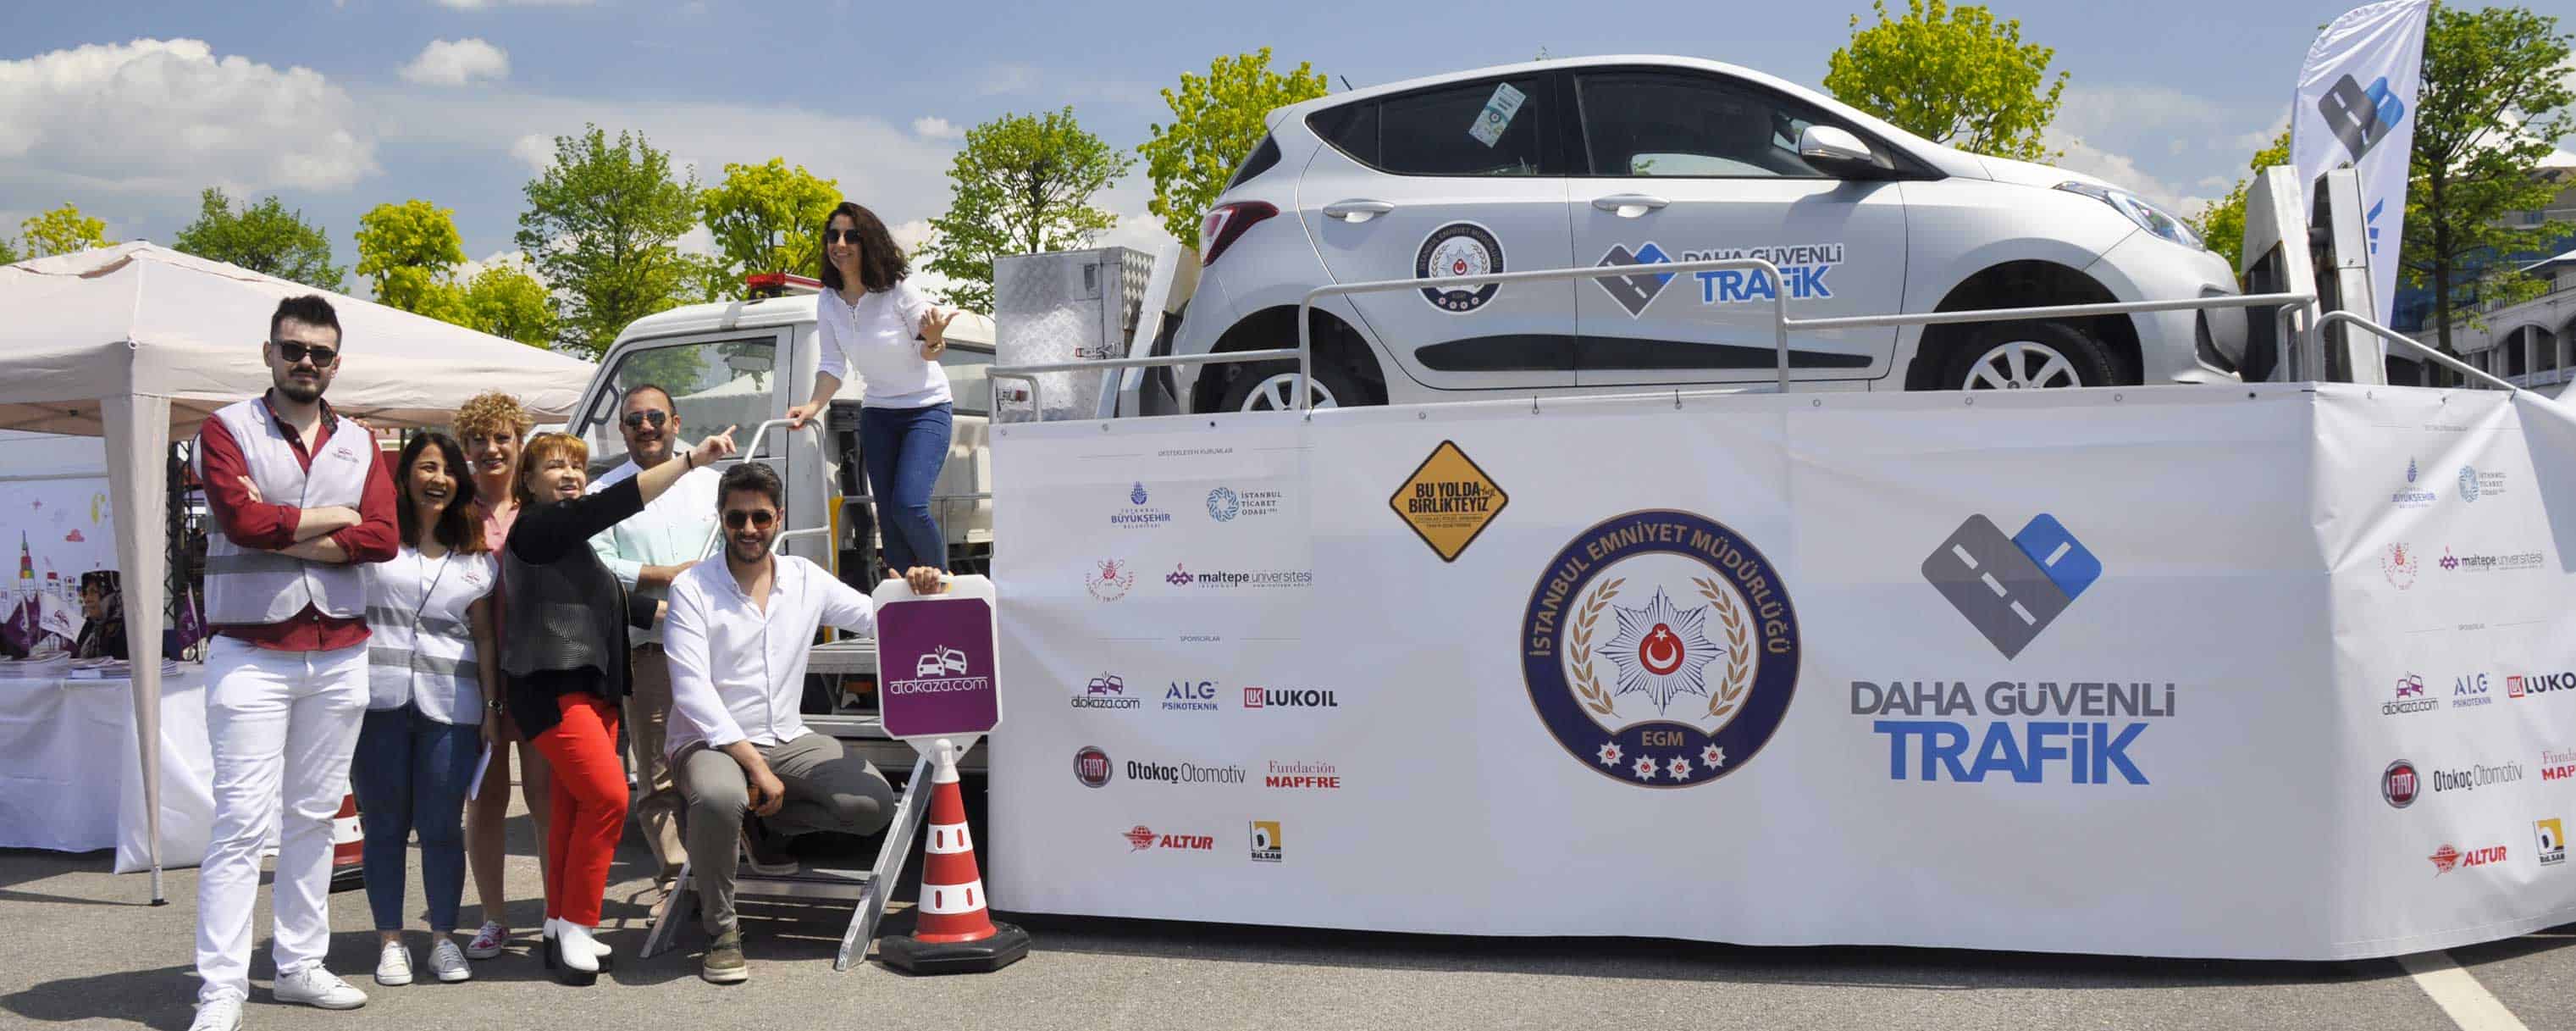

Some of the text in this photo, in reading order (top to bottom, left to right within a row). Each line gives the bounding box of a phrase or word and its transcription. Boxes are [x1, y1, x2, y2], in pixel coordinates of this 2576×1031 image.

[1416, 483, 1434, 497] BU
[1438, 481, 1480, 497] YOLDA
[2461, 553, 2496, 570] maltepe
[1198, 570, 1249, 587] maltepe
[1586, 521, 1688, 561] EMNİYET
[1690, 529, 1792, 654] MÜDÜRLÜĞÜ
[1165, 681, 1215, 699] ALG
[1265, 689, 1338, 707] LUKOIL
[1851, 680, 1977, 716] DAHA
[1642, 730, 1684, 746] EGM
[1084, 758, 1104, 777] FIAT
[1127, 761, 1246, 784] Otokoç Otomotiv
[1269, 760, 1335, 773] Fundación
[1266, 776, 1341, 788] MAPFRE
[2391, 773, 2413, 795] FIAT
[2434, 761, 2523, 792] Otokoç Otomotiv
[1159, 834, 1213, 850] ALTUR
[2463, 845, 2507, 867] ALTUR
